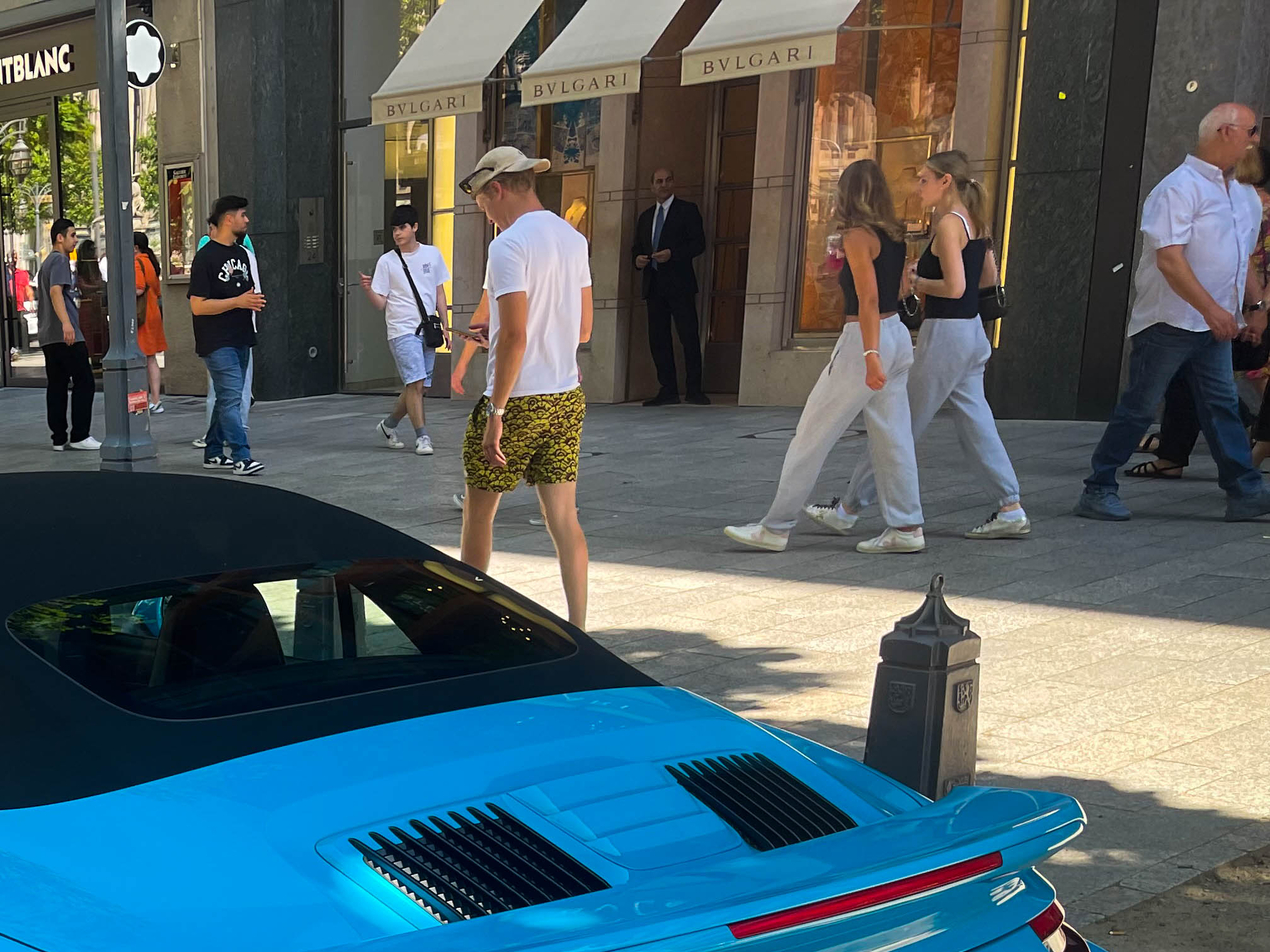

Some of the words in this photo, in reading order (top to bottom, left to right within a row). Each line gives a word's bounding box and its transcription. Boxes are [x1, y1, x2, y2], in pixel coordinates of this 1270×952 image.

[703, 45, 813, 75] BVLGARI
[533, 72, 627, 98] BVLGARI
[386, 94, 466, 117] BVLGARI
